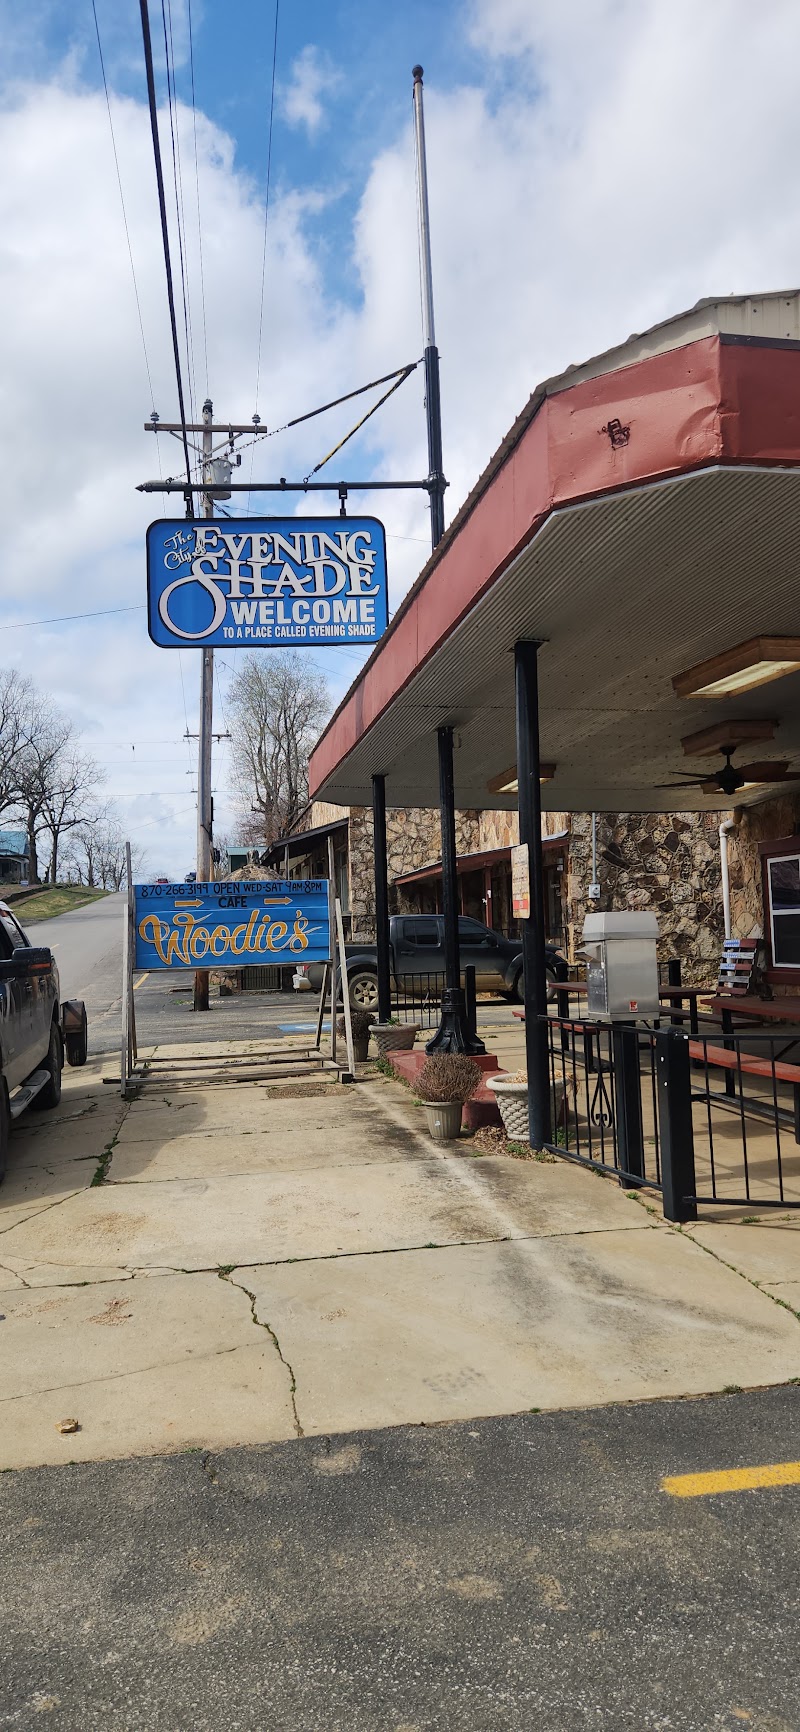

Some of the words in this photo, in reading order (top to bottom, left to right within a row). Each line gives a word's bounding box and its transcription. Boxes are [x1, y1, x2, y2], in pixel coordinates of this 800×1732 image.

[164, 530, 193, 549] The
[193, 526, 377, 566] EVENING
[164, 546, 192, 570] City
[159, 556, 380, 640] SHADE
[230, 599, 376, 625] WELCOME
[223, 626, 234, 639] TO
[237, 626, 243, 639] A
[245, 626, 272, 638] PLACE
[275, 625, 307, 637] CALLED
[309, 625, 345, 637] EVENING
[348, 624, 376, 636] SHADE
[141, 884, 209, 897] 870-266-3199
[213, 883, 240, 895] OPEN
[243, 882, 283, 893] WED-SAT
[218, 896, 248, 908] CAFE
[139, 909, 323, 965] Woodie's
